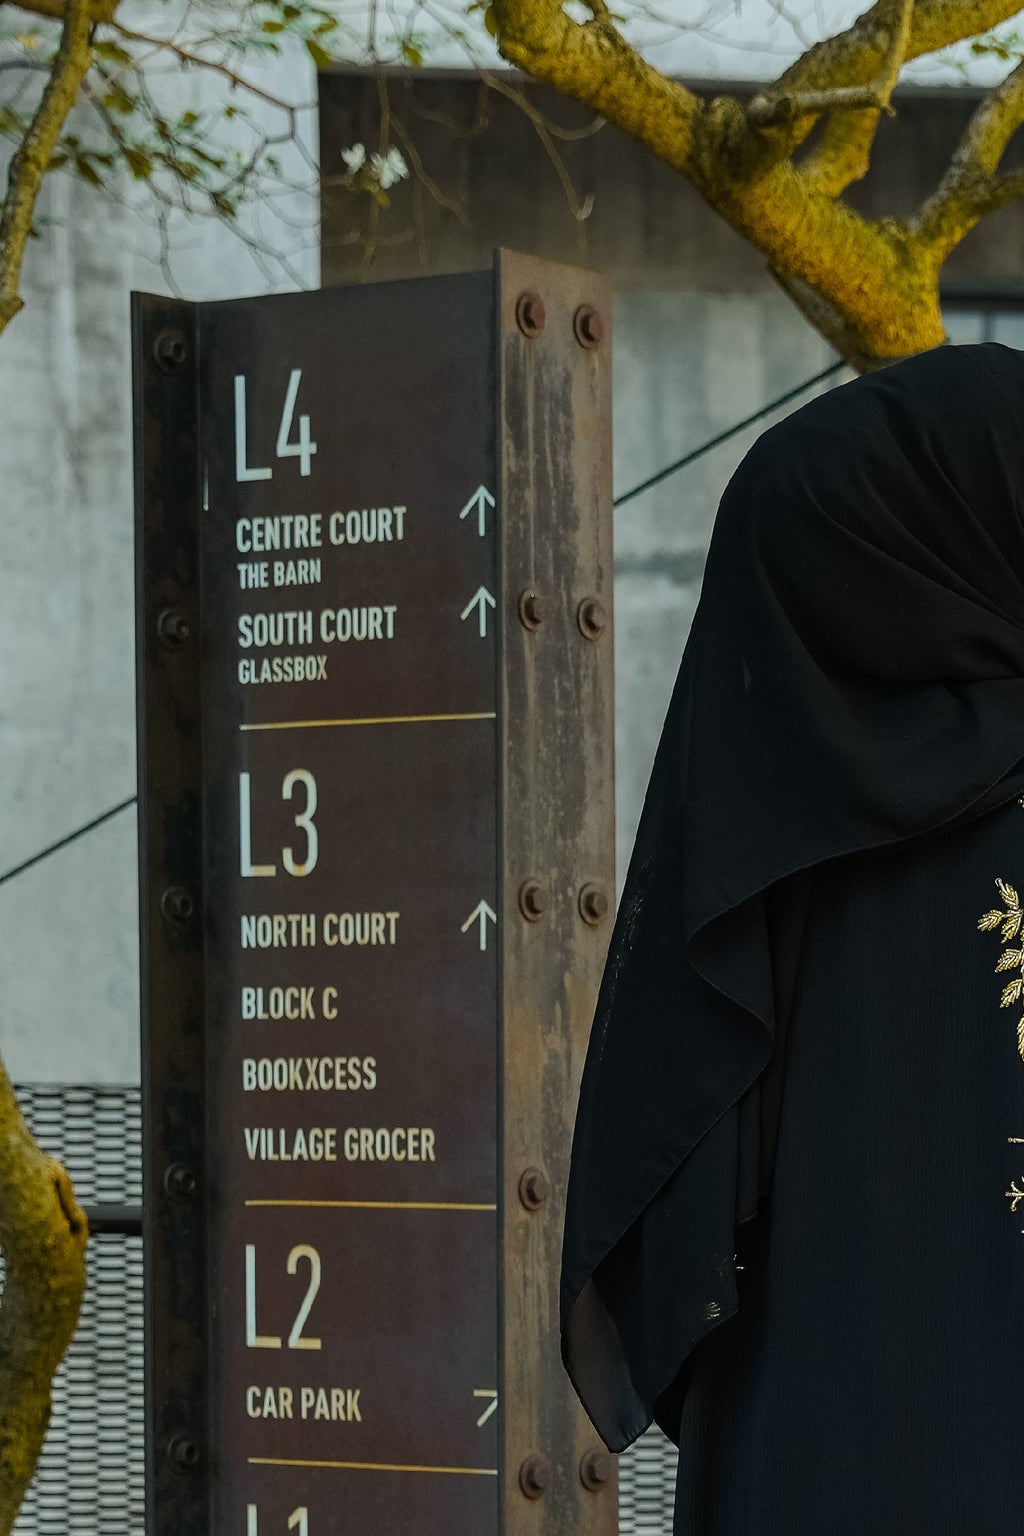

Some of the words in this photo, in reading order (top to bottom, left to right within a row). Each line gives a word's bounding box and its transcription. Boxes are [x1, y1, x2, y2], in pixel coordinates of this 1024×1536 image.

[234, 368, 317, 481] L4
[236, 514, 322, 553] CENTRE
[329, 506, 407, 546] COURT
[237, 563, 269, 589] THE
[274, 559, 321, 586] BARN
[238, 610, 313, 648] SOUTH
[320, 605, 397, 643] COURT
[238, 655, 328, 684] GLASSBOX
[239, 768, 319, 877] L3
[240, 914, 316, 949] NORTH
[323, 912, 400, 946] COURT
[241, 986, 316, 1020] BLOCK
[323, 986, 338, 1020] C
[242, 1056, 377, 1091] BOOKXCESS
[244, 1127, 337, 1161] VILLAGE
[344, 1127, 436, 1162] GROCER
[245, 1243, 322, 1350] L2
[246, 1385, 293, 1419] CAR
[300, 1386, 362, 1422] PARK
